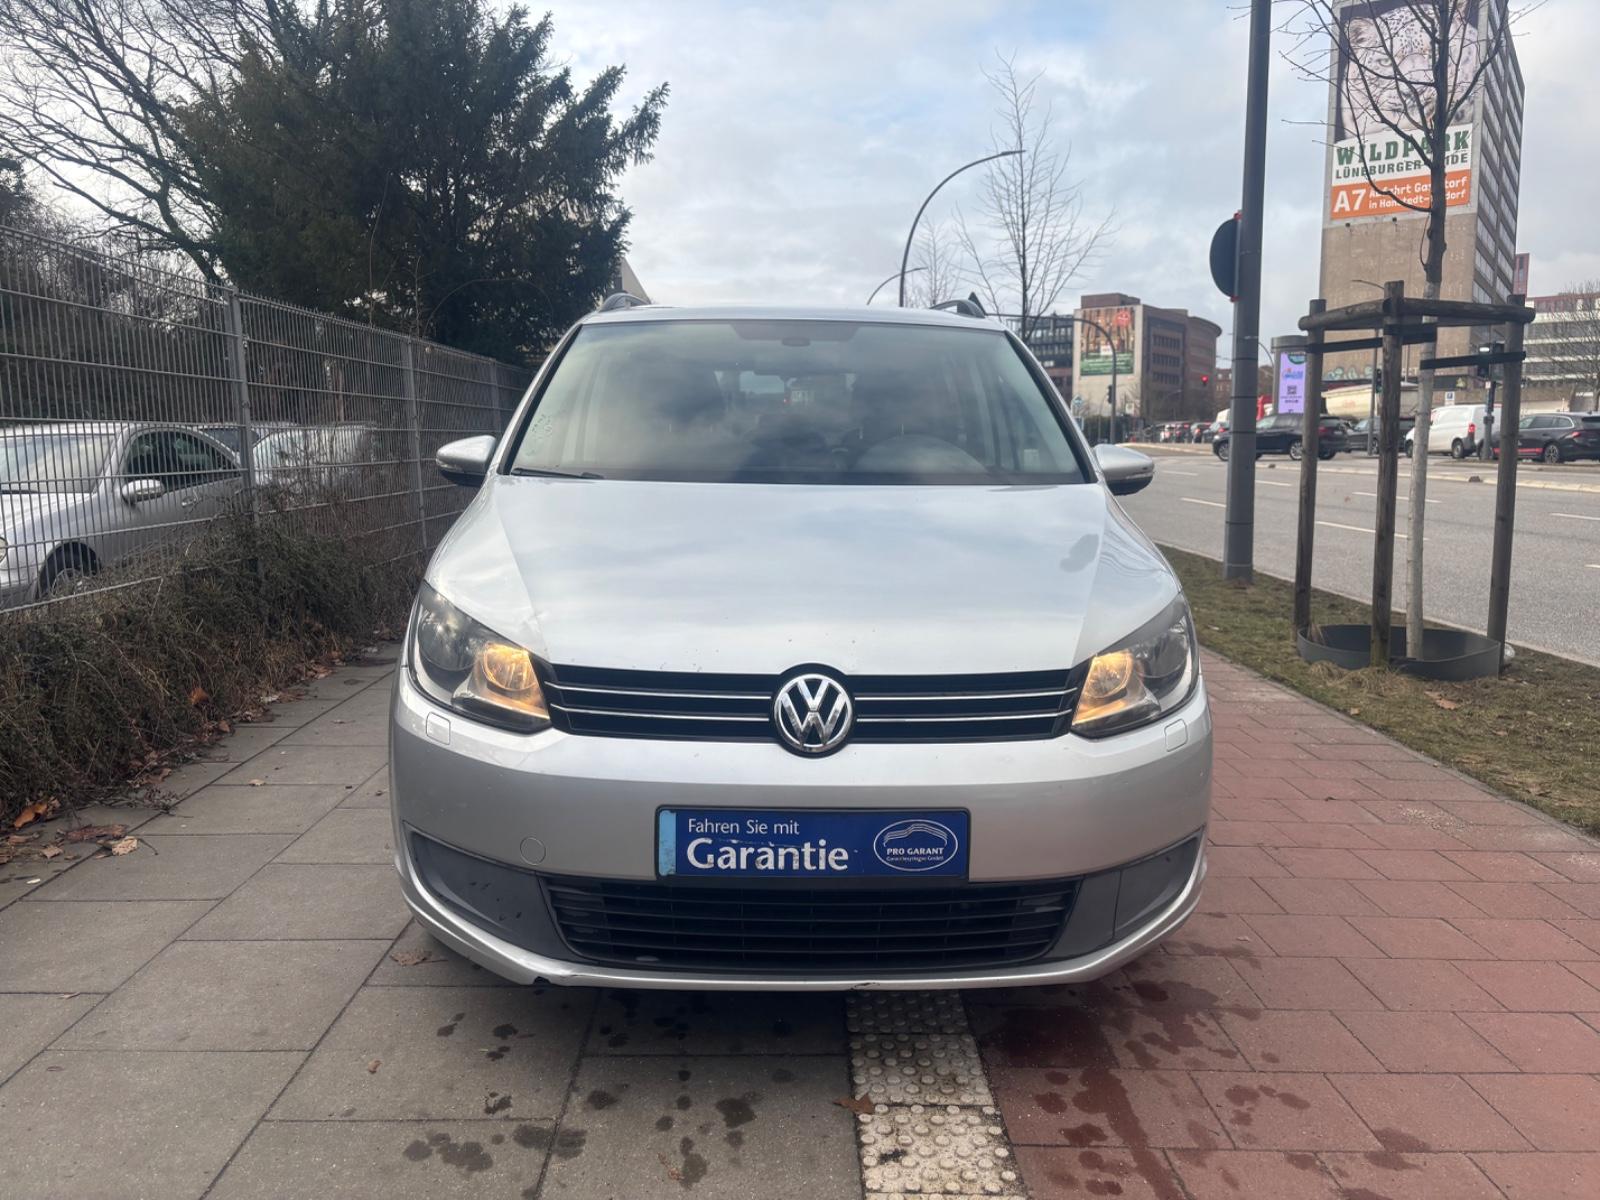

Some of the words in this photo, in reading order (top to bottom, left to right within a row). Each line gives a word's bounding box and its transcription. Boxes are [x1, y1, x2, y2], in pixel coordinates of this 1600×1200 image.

[1336, 159, 1421, 179] LÜNEBURGER
[1333, 188, 1366, 213] A7
[1369, 199, 1377, 209] in
[688, 818, 740, 834] Fahren
[746, 819, 768, 835] Sie
[773, 820, 800, 835] mit
[686, 837, 849, 871] Garantie
[886, 847, 905, 856] PRO
[907, 847, 945, 856] GARANT
